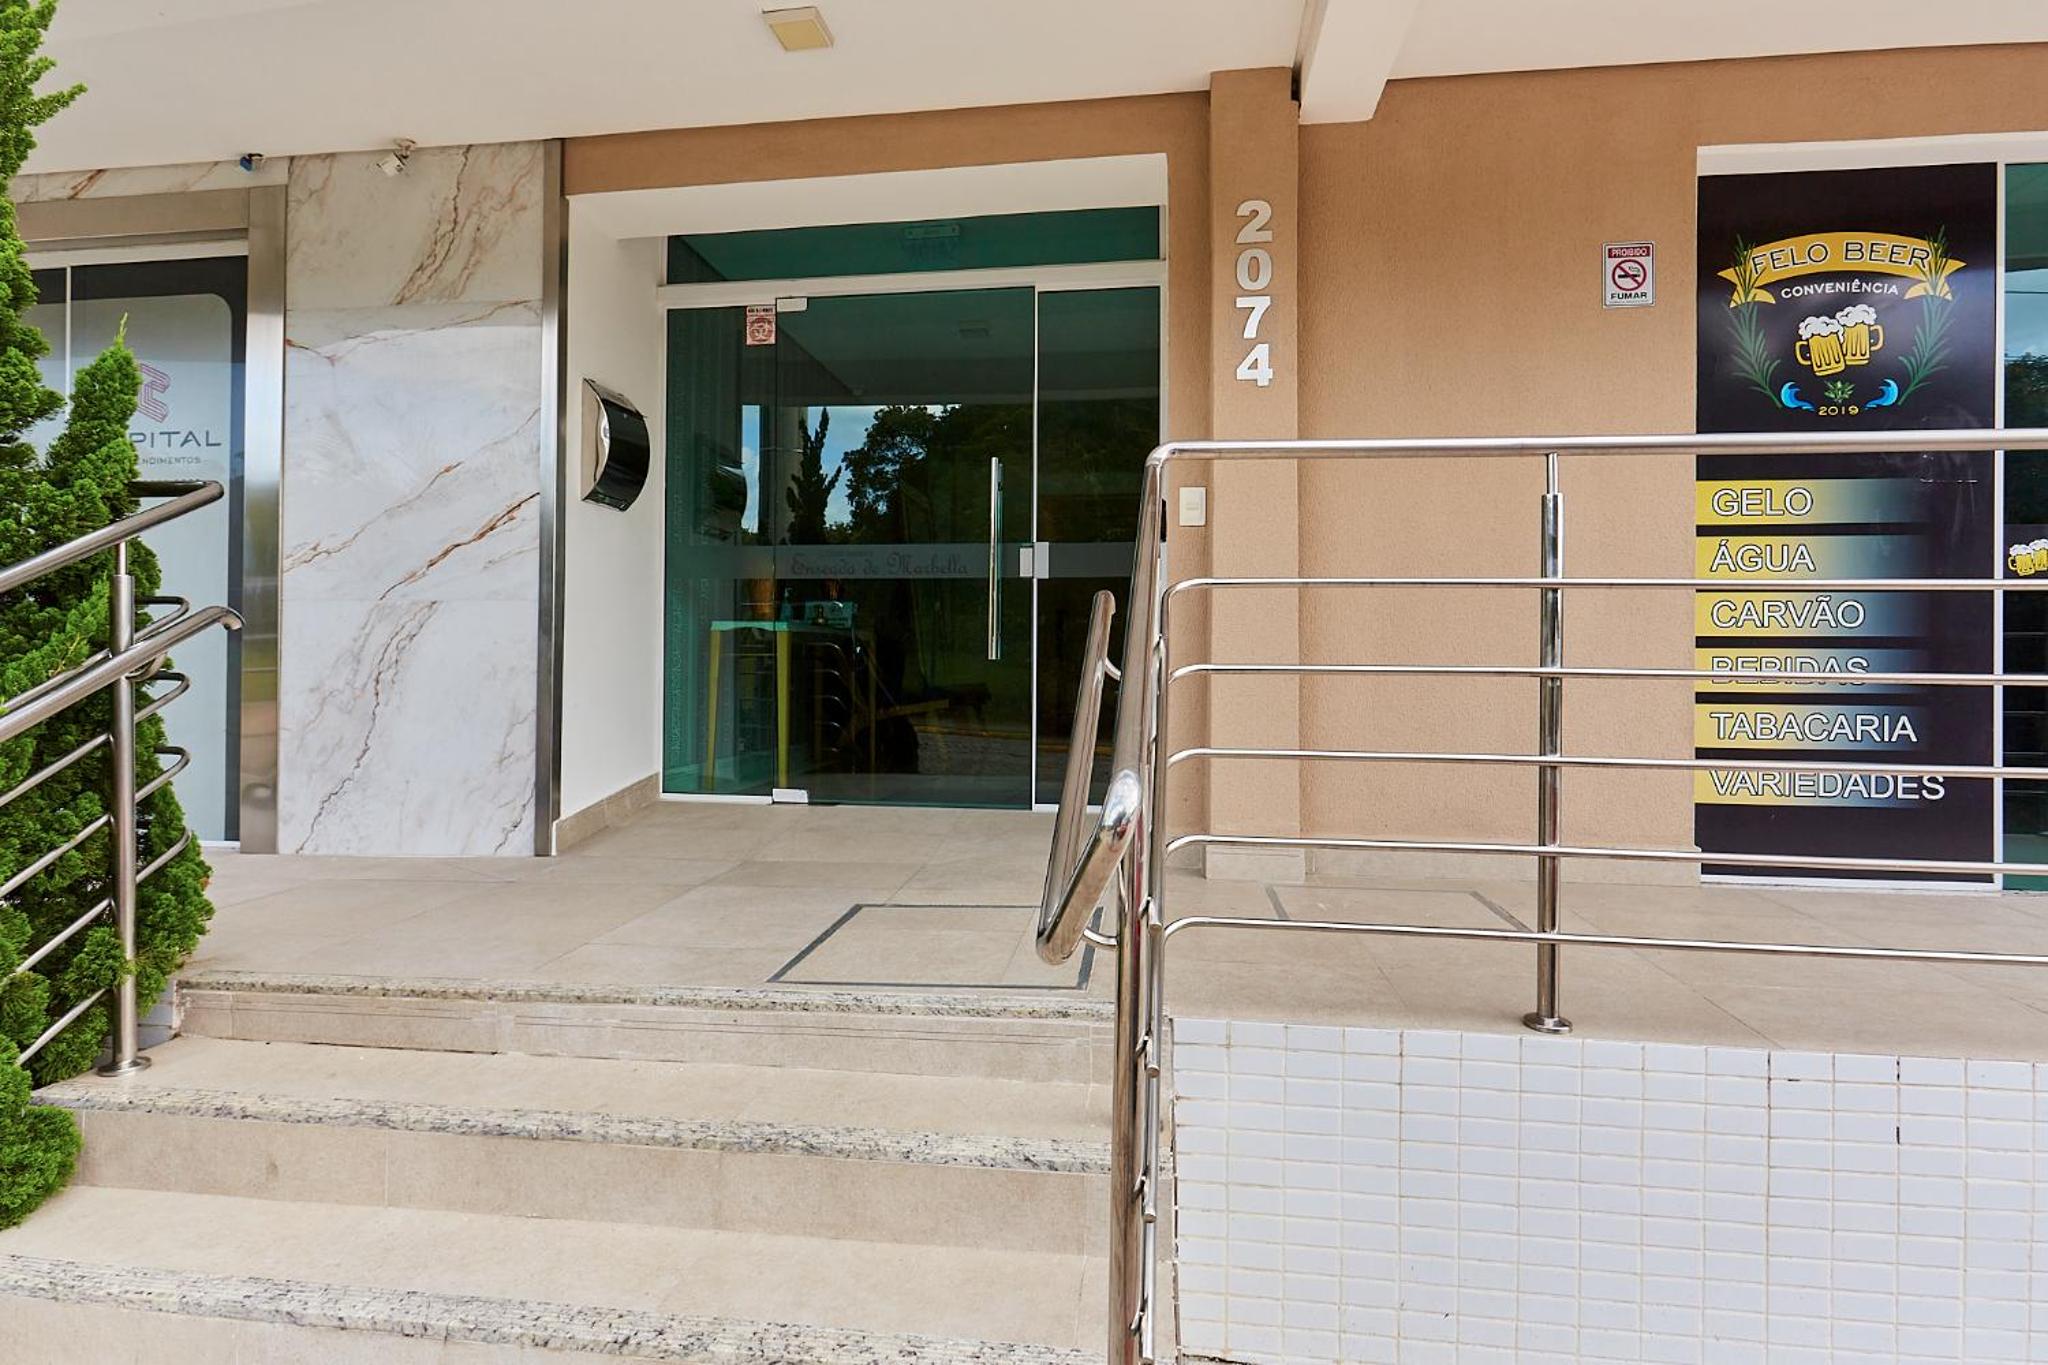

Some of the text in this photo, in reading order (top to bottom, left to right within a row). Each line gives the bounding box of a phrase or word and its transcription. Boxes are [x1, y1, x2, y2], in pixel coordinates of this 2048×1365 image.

[1611, 247, 1648, 257] PROIBIDO
[1751, 241, 1931, 275] FELO BEER
[1236, 200, 1274, 387] 2074
[1610, 291, 1648, 300] FUMAR
[1780, 279, 1899, 299] CONVENIÊNCIA
[1818, 405, 1859, 416] 2019
[129, 429, 222, 448] PITAL
[1711, 487, 1814, 517] GELO
[1710, 539, 1816, 573] ÁGUA
[1711, 596, 1866, 629] CARVÃO
[1711, 656, 1870, 686] BEBIDAS
[1710, 712, 1918, 742] TABACARIA
[1710, 769, 1946, 800] VARIEDADES
